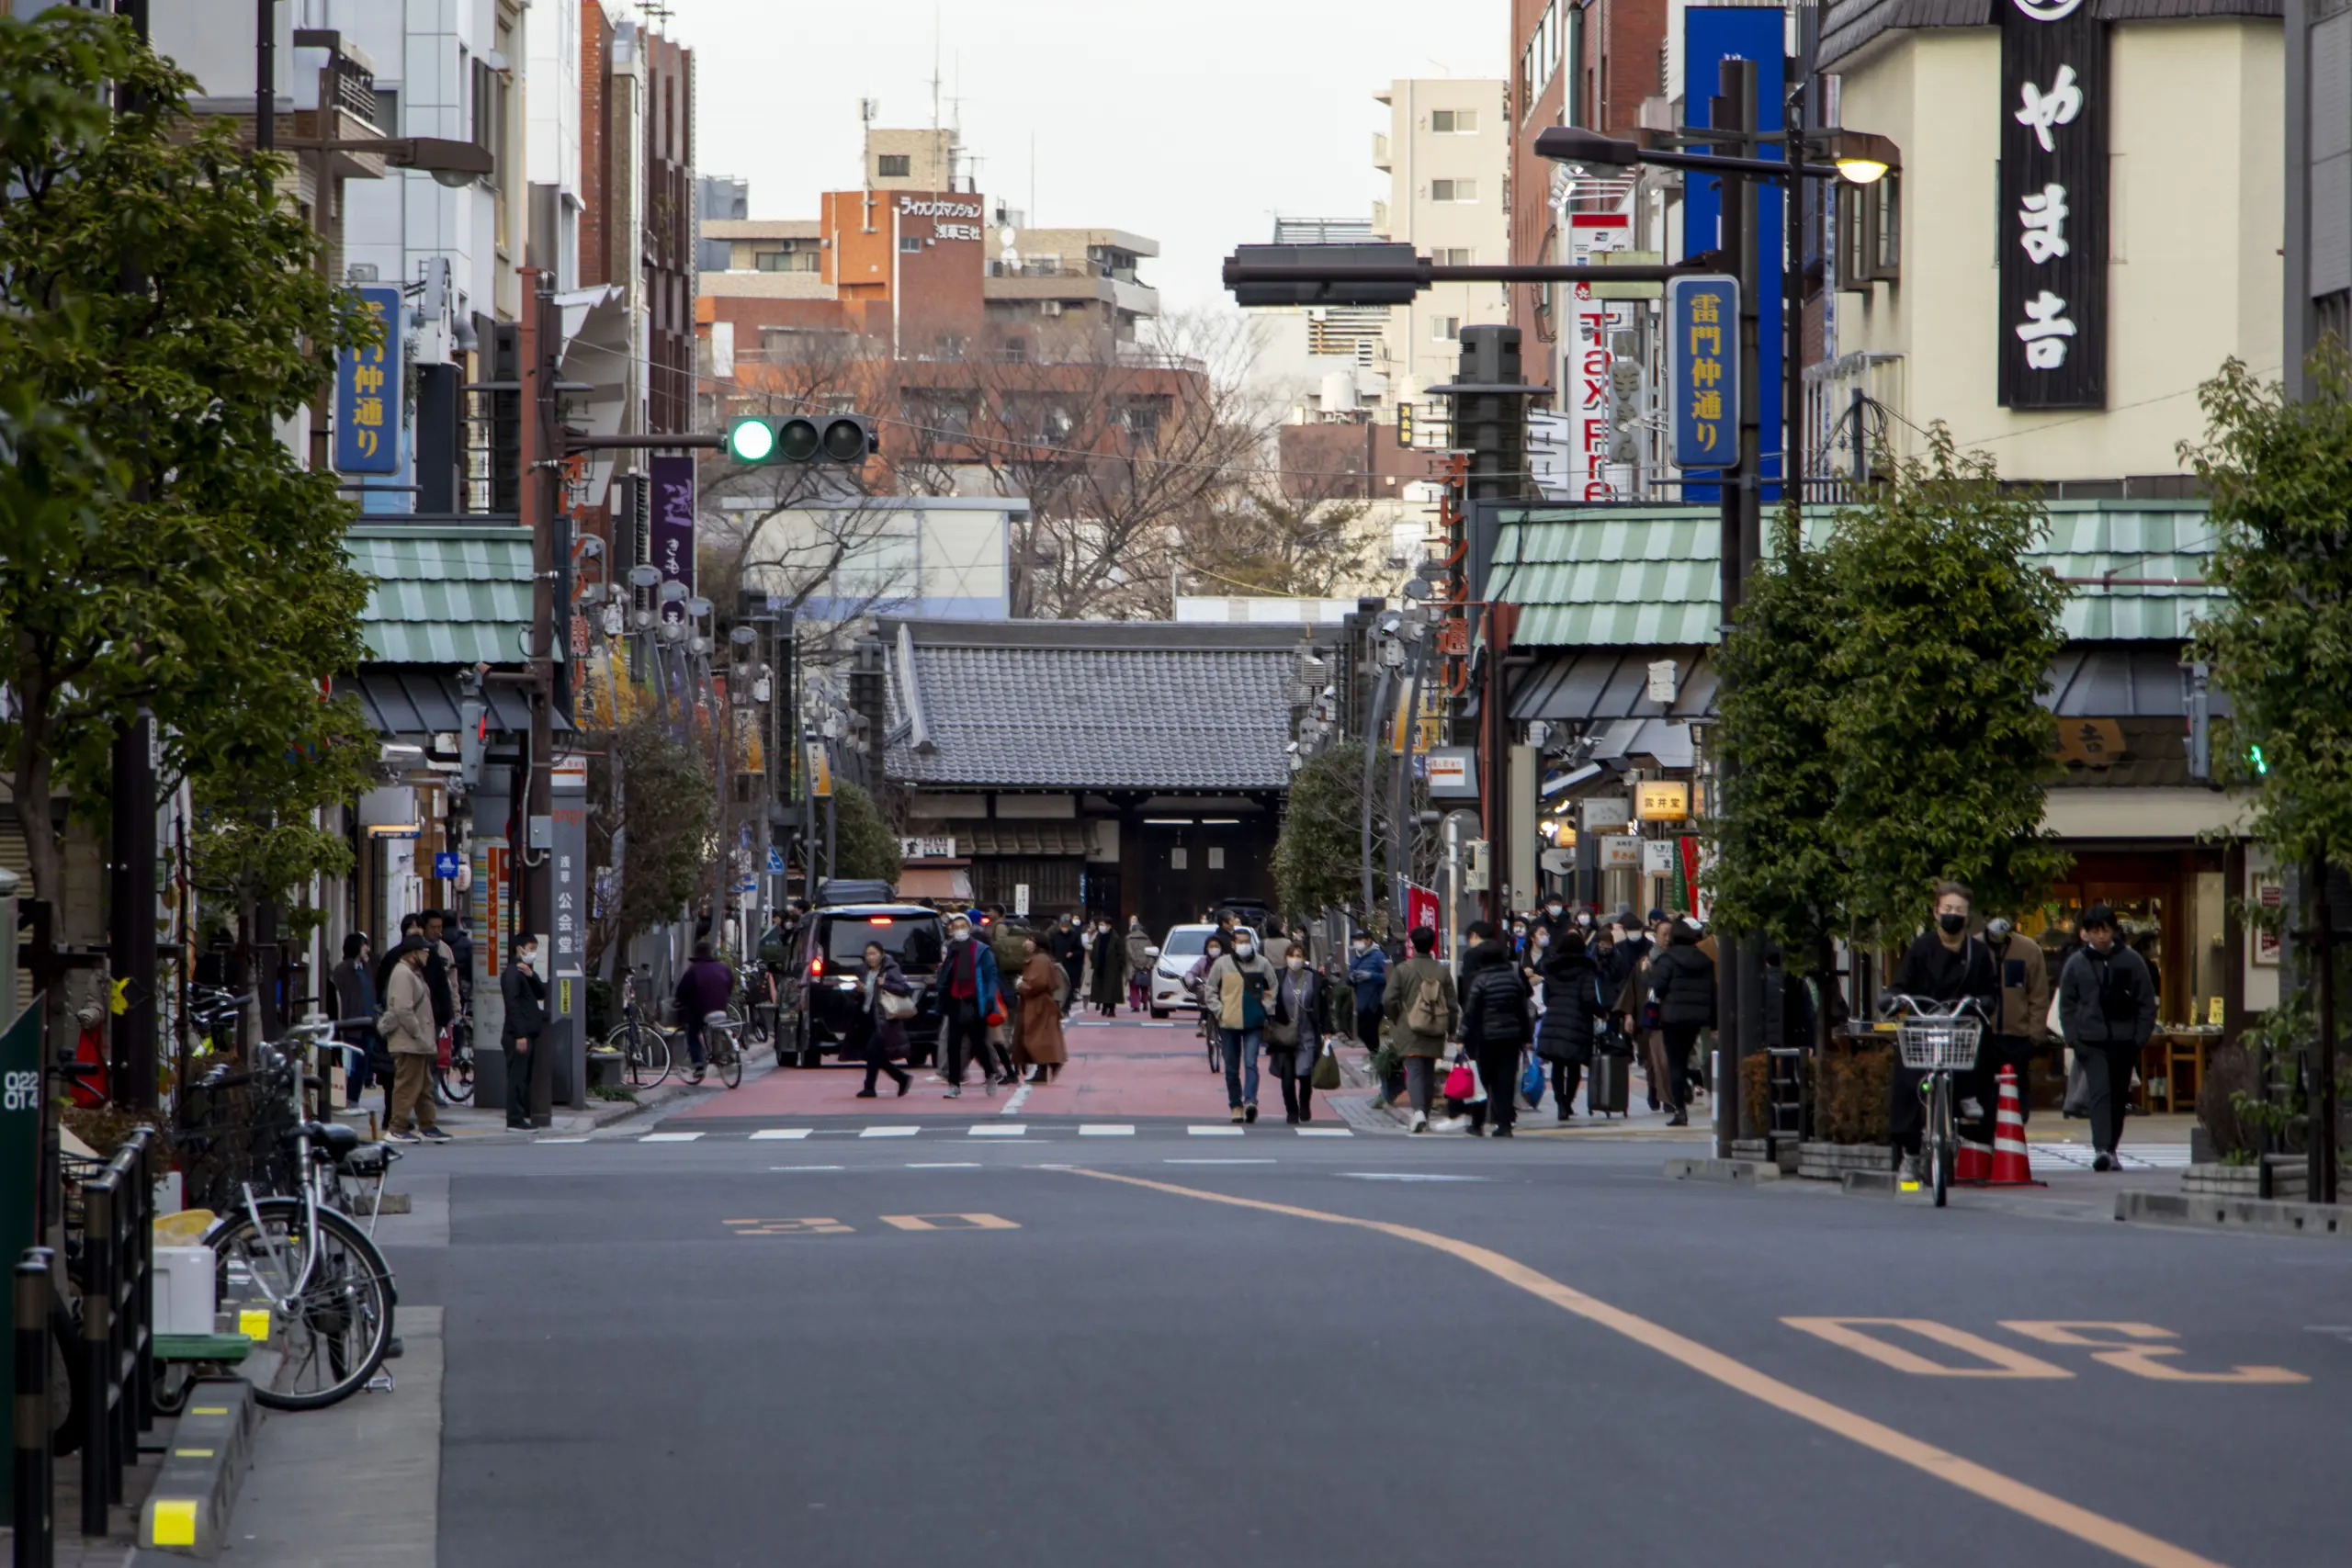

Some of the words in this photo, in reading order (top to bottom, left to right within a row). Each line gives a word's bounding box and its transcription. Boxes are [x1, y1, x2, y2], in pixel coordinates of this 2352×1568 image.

[900, 196, 982, 218] ライオンズマンション
[2014, 63, 2084, 369] やま吉
[1690, 293, 1722, 452] 雷門仲通り
[4, 1071, 39, 1091] 022
[4, 1091, 39, 1110] 014
